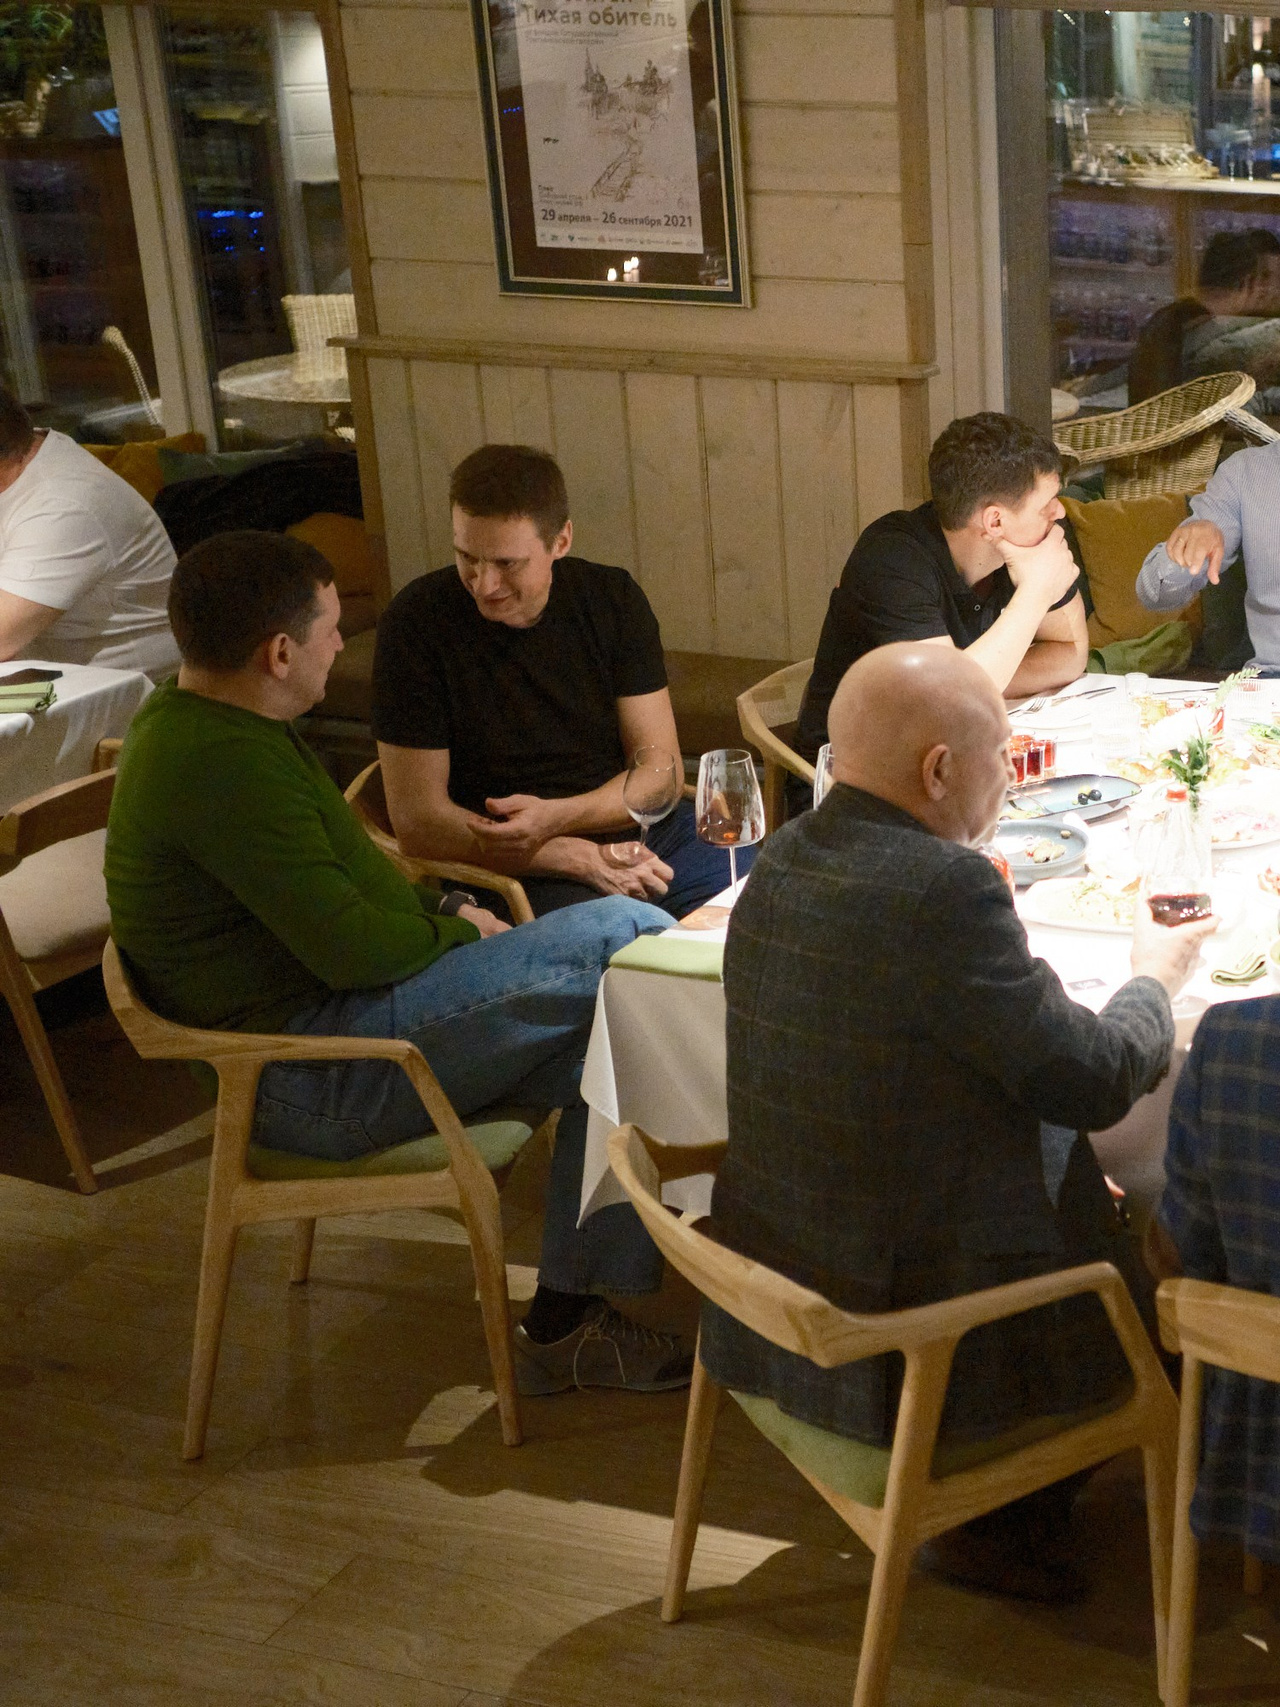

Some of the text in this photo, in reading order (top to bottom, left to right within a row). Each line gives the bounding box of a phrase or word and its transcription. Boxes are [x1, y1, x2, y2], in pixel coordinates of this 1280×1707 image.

[521, 5, 678, 28] Тихая обитель
[541, 209, 556, 221] 29
[557, 213, 592, 224] апреля
[601, 211, 616, 224] 26
[618, 214, 662, 228] сентября
[663, 214, 693, 228] 2021
